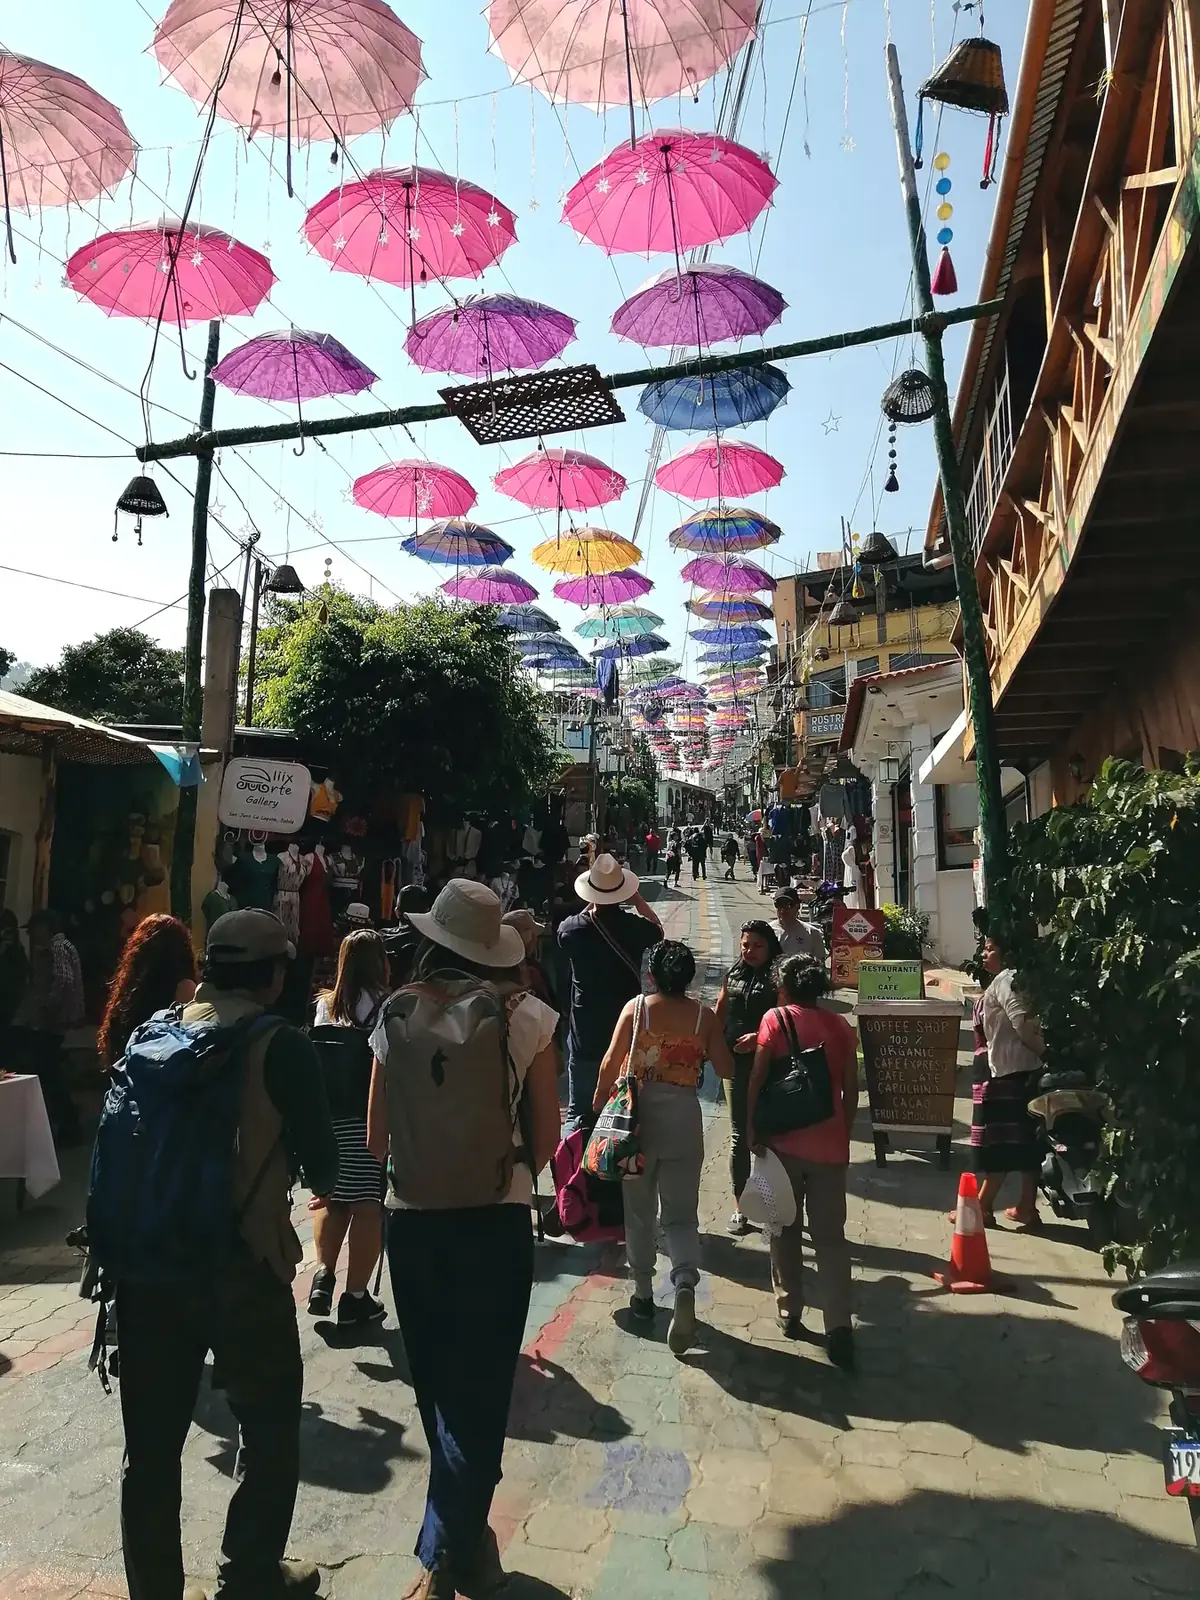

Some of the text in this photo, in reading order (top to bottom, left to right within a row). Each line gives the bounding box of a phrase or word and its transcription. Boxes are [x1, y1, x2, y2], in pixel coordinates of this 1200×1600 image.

[246, 796, 279, 808] Gallery
[866, 1020, 949, 1034] COFFEE SHOP
[890, 1035, 908, 1044] 100
[880, 1045, 934, 1057] ORGANIC
[875, 1058, 901, 1069] CAFE
[878, 1070, 904, 1082] CAFE
[893, 1097, 930, 1108] CACAO
[874, 1109, 900, 1120] FRUIT
